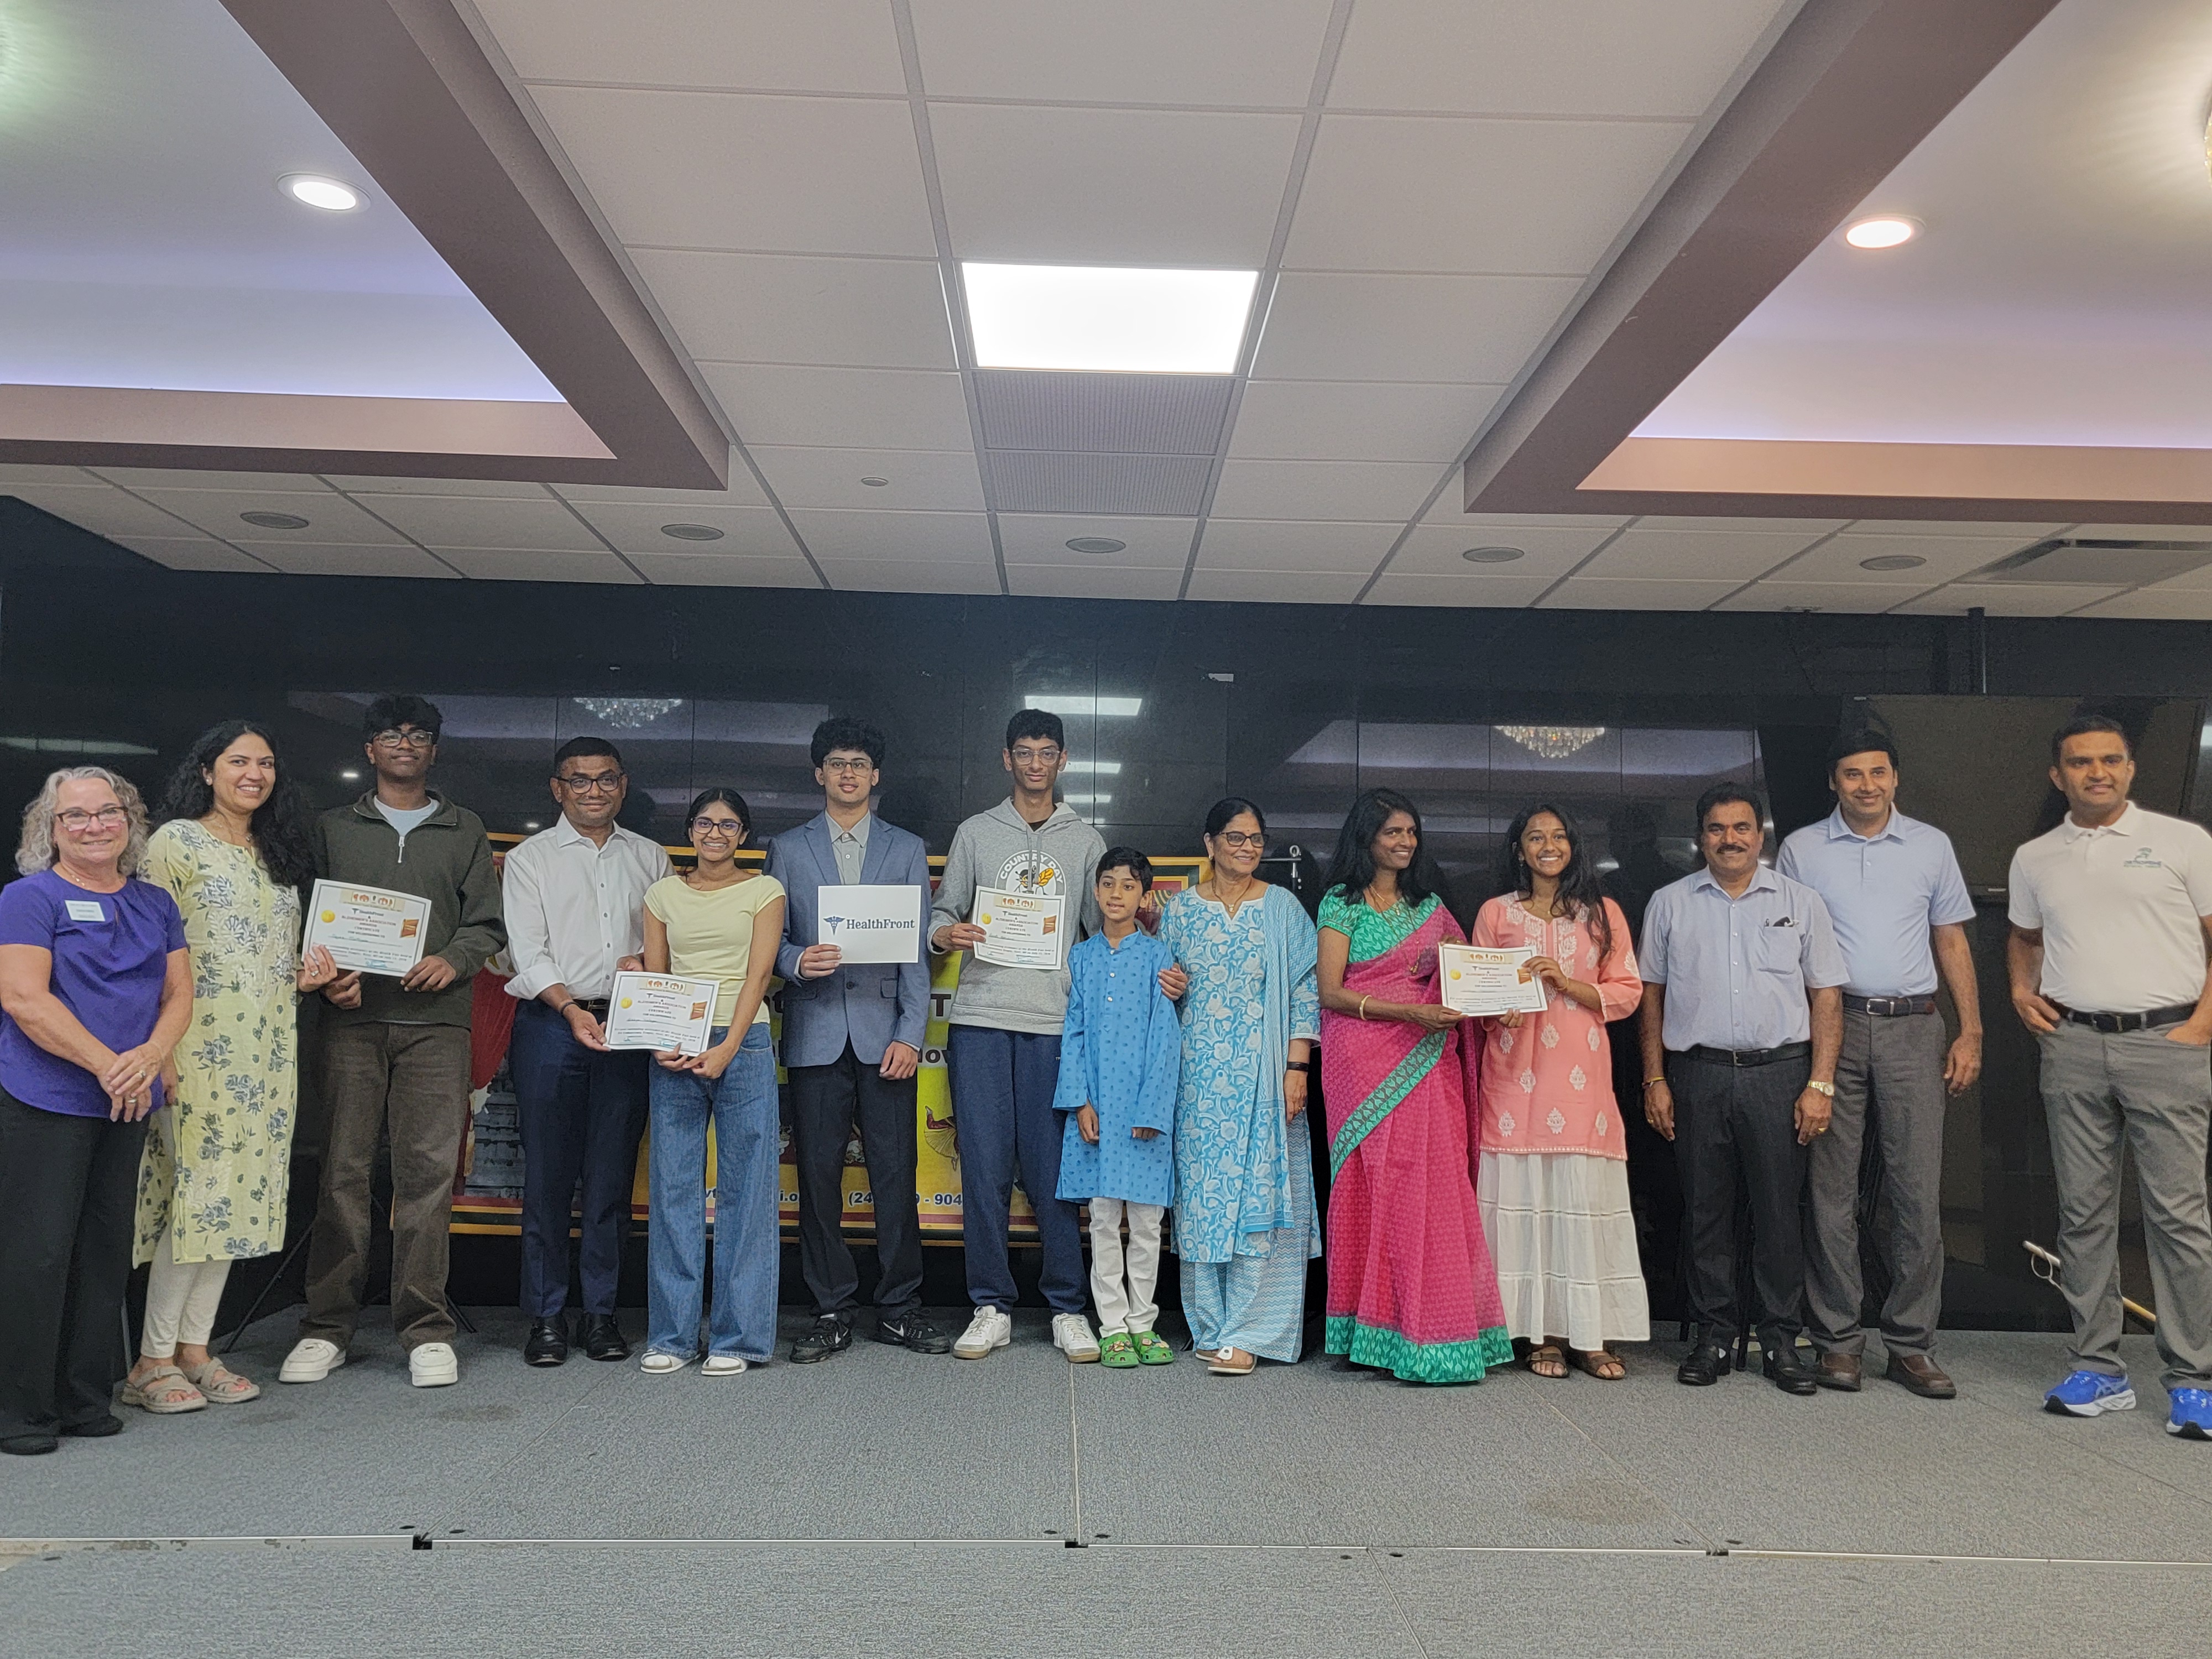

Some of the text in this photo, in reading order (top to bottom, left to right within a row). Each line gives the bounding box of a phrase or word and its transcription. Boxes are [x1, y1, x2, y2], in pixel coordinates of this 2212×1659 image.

[1000, 853, 1063, 884] COUNTRY DAY
[846, 919, 915, 929] HealthFront
